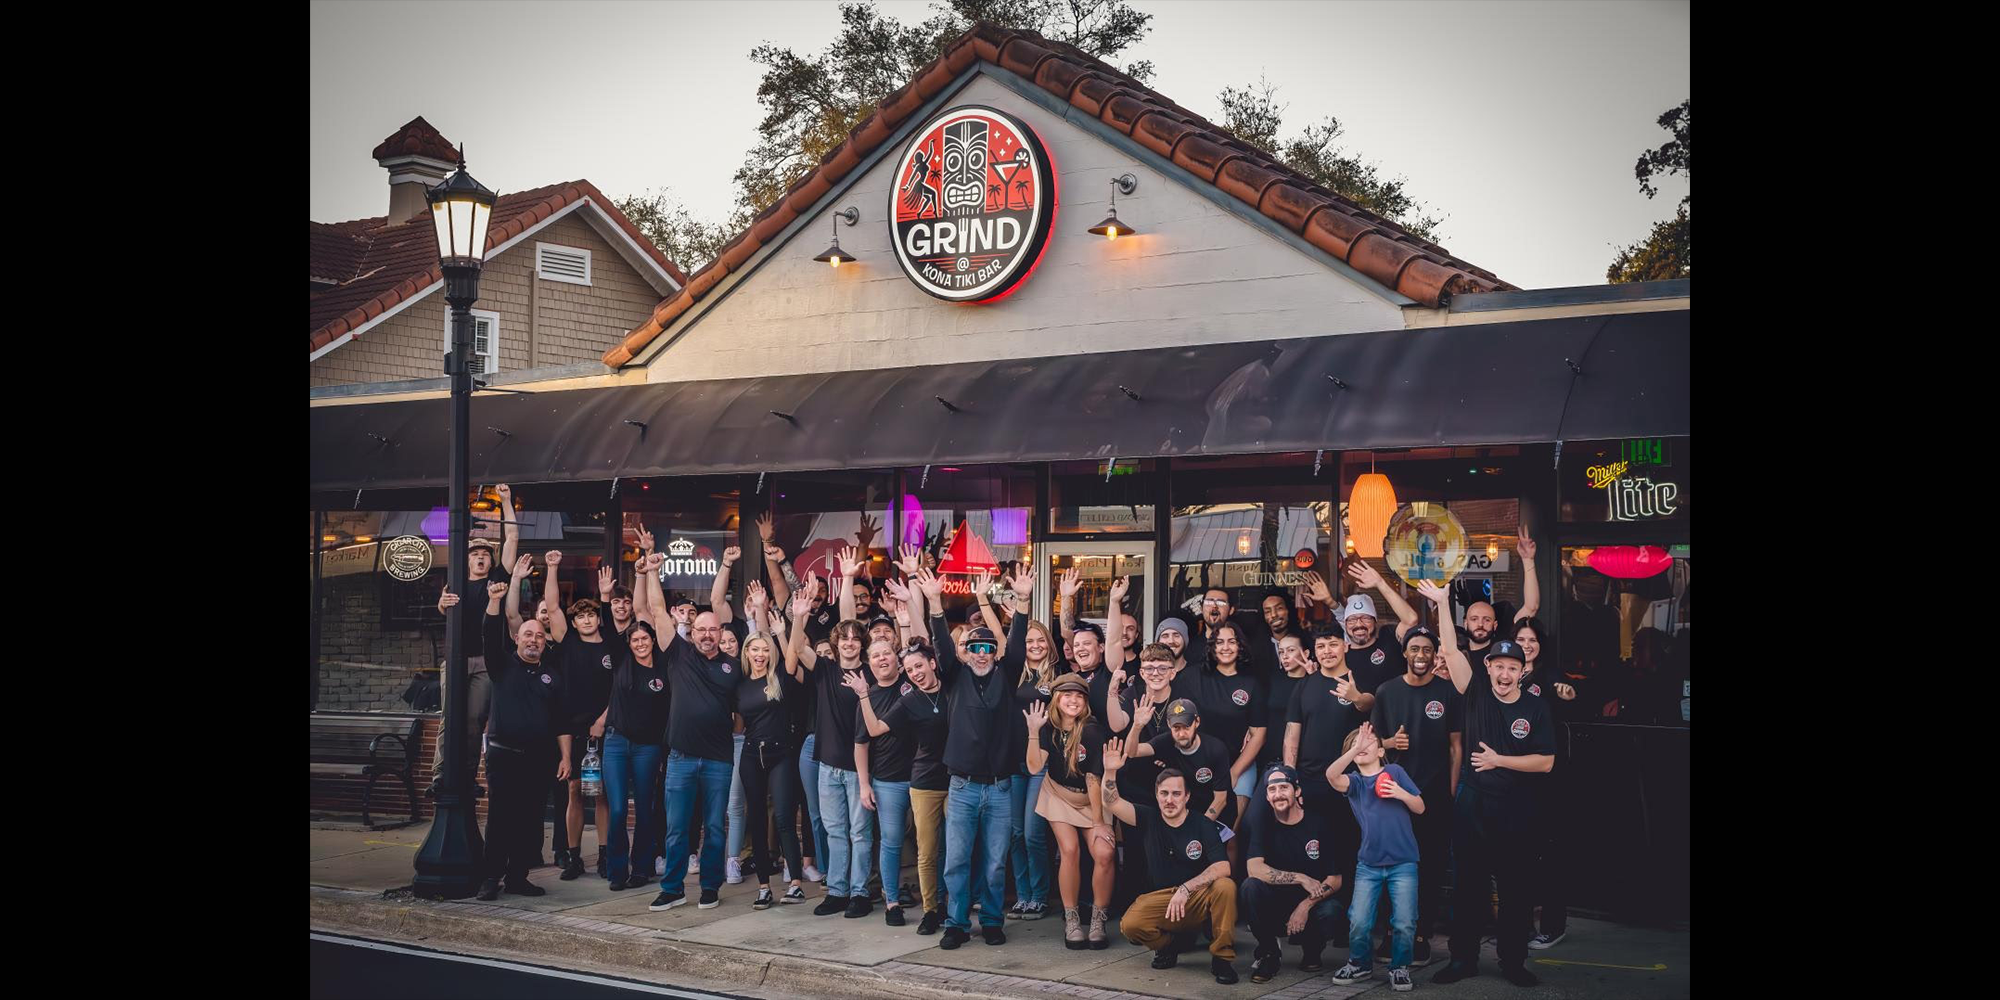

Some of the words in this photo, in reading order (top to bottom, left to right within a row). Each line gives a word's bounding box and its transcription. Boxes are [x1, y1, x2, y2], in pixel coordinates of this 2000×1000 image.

[906, 217, 1021, 257] GRIND
[922, 263, 951, 287] KONA
[955, 274, 976, 288] TIKI
[978, 259, 1002, 282] BAR
[956, 257, 970, 271] @
[1586, 461, 1628, 485] Miller
[941, 579, 970, 594] oors
[1242, 571, 1308, 587] GUINNES
